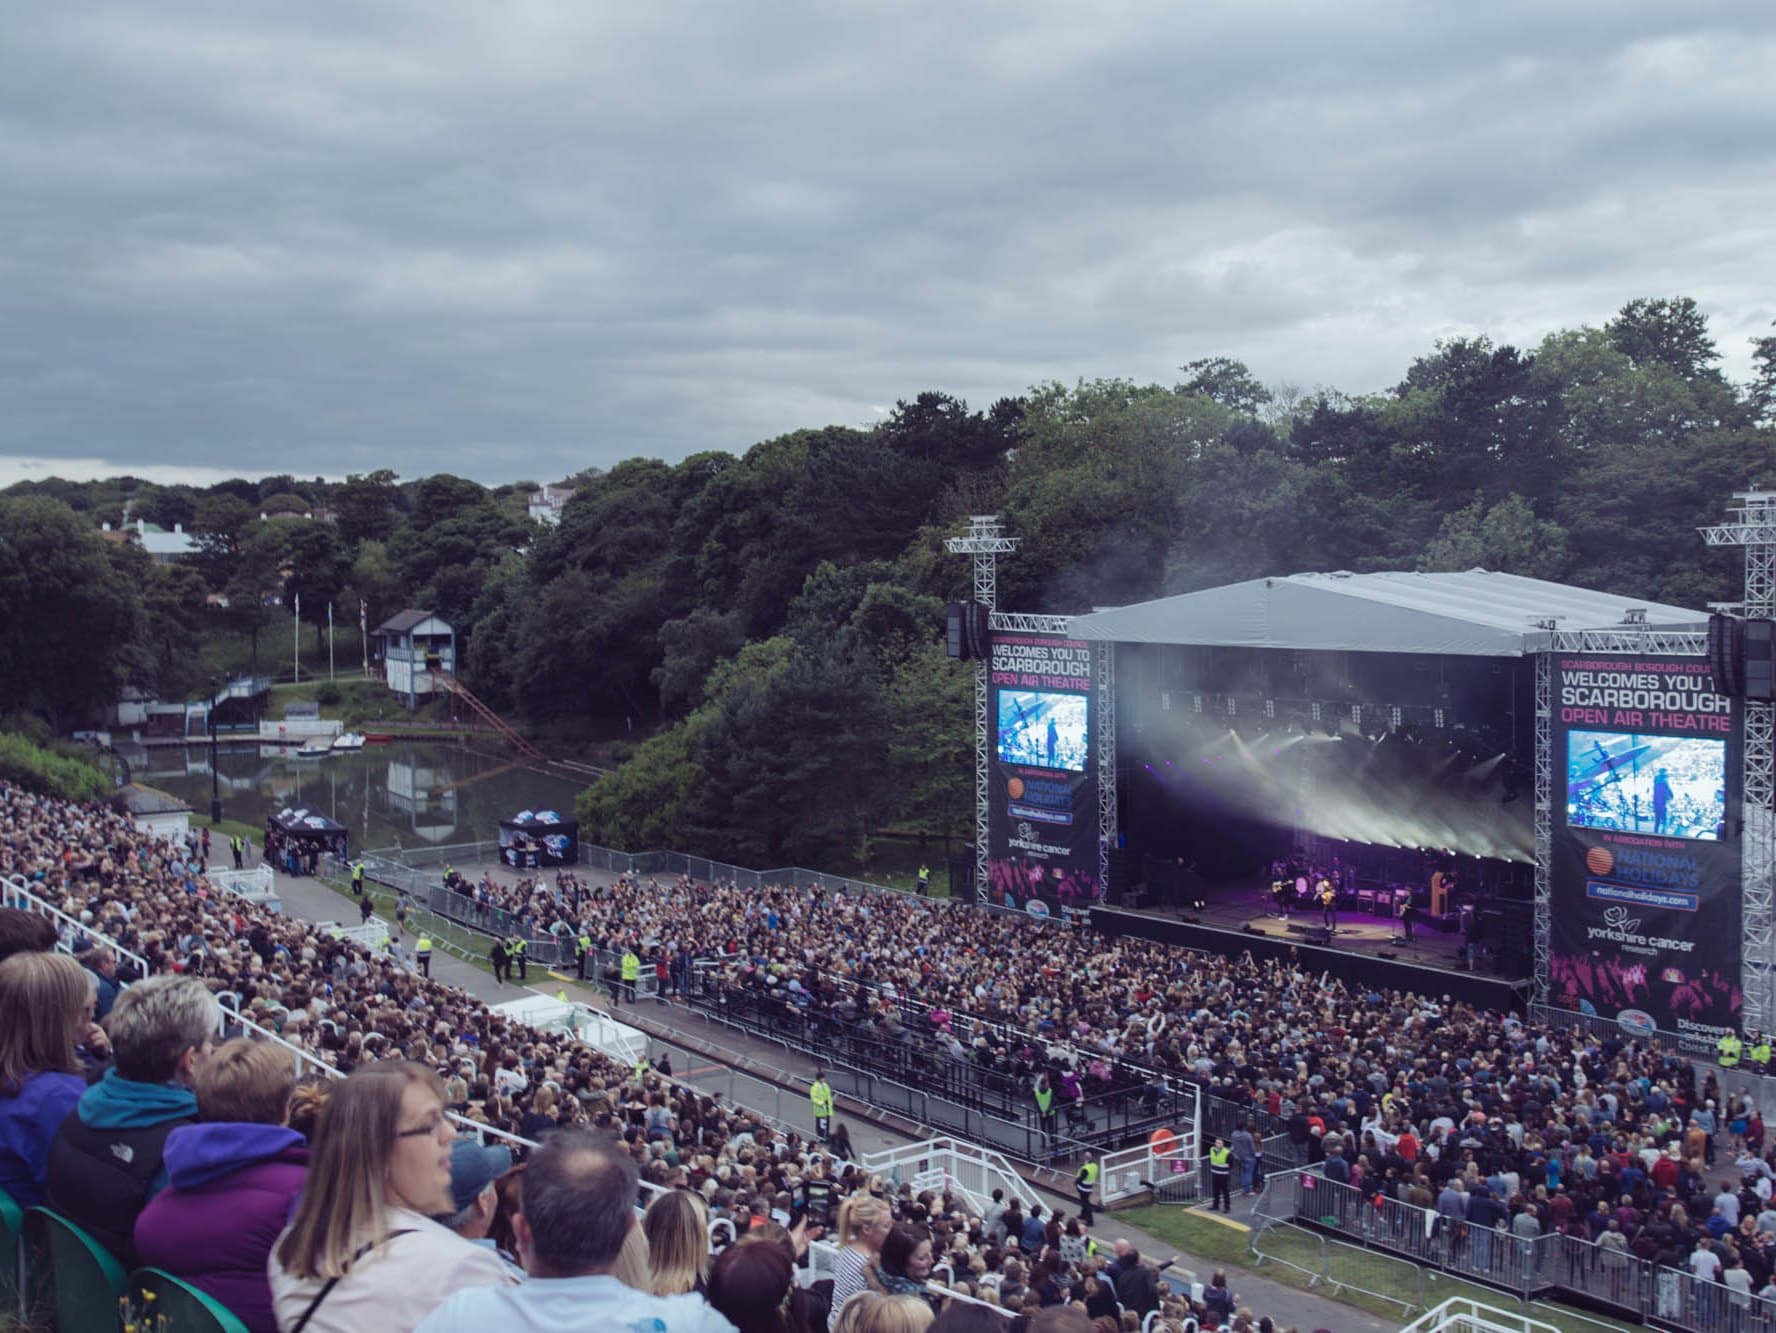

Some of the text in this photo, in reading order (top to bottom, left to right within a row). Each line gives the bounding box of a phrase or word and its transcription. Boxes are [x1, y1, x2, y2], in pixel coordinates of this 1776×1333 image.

[992, 644, 1090, 662] WELCOMES YOU TO
[992, 657, 1090, 677] SCARBOROUGH
[992, 672, 1090, 690] OPEN AIR THEATRE
[1561, 671, 1659, 690] WELCOMES
[1664, 675, 1703, 691] YOU
[1561, 687, 1731, 714] SCARBOROUGH
[1561, 707, 1731, 732] OPEN AIR THEATRE
[1587, 926, 1696, 952] yorkshire cancer
